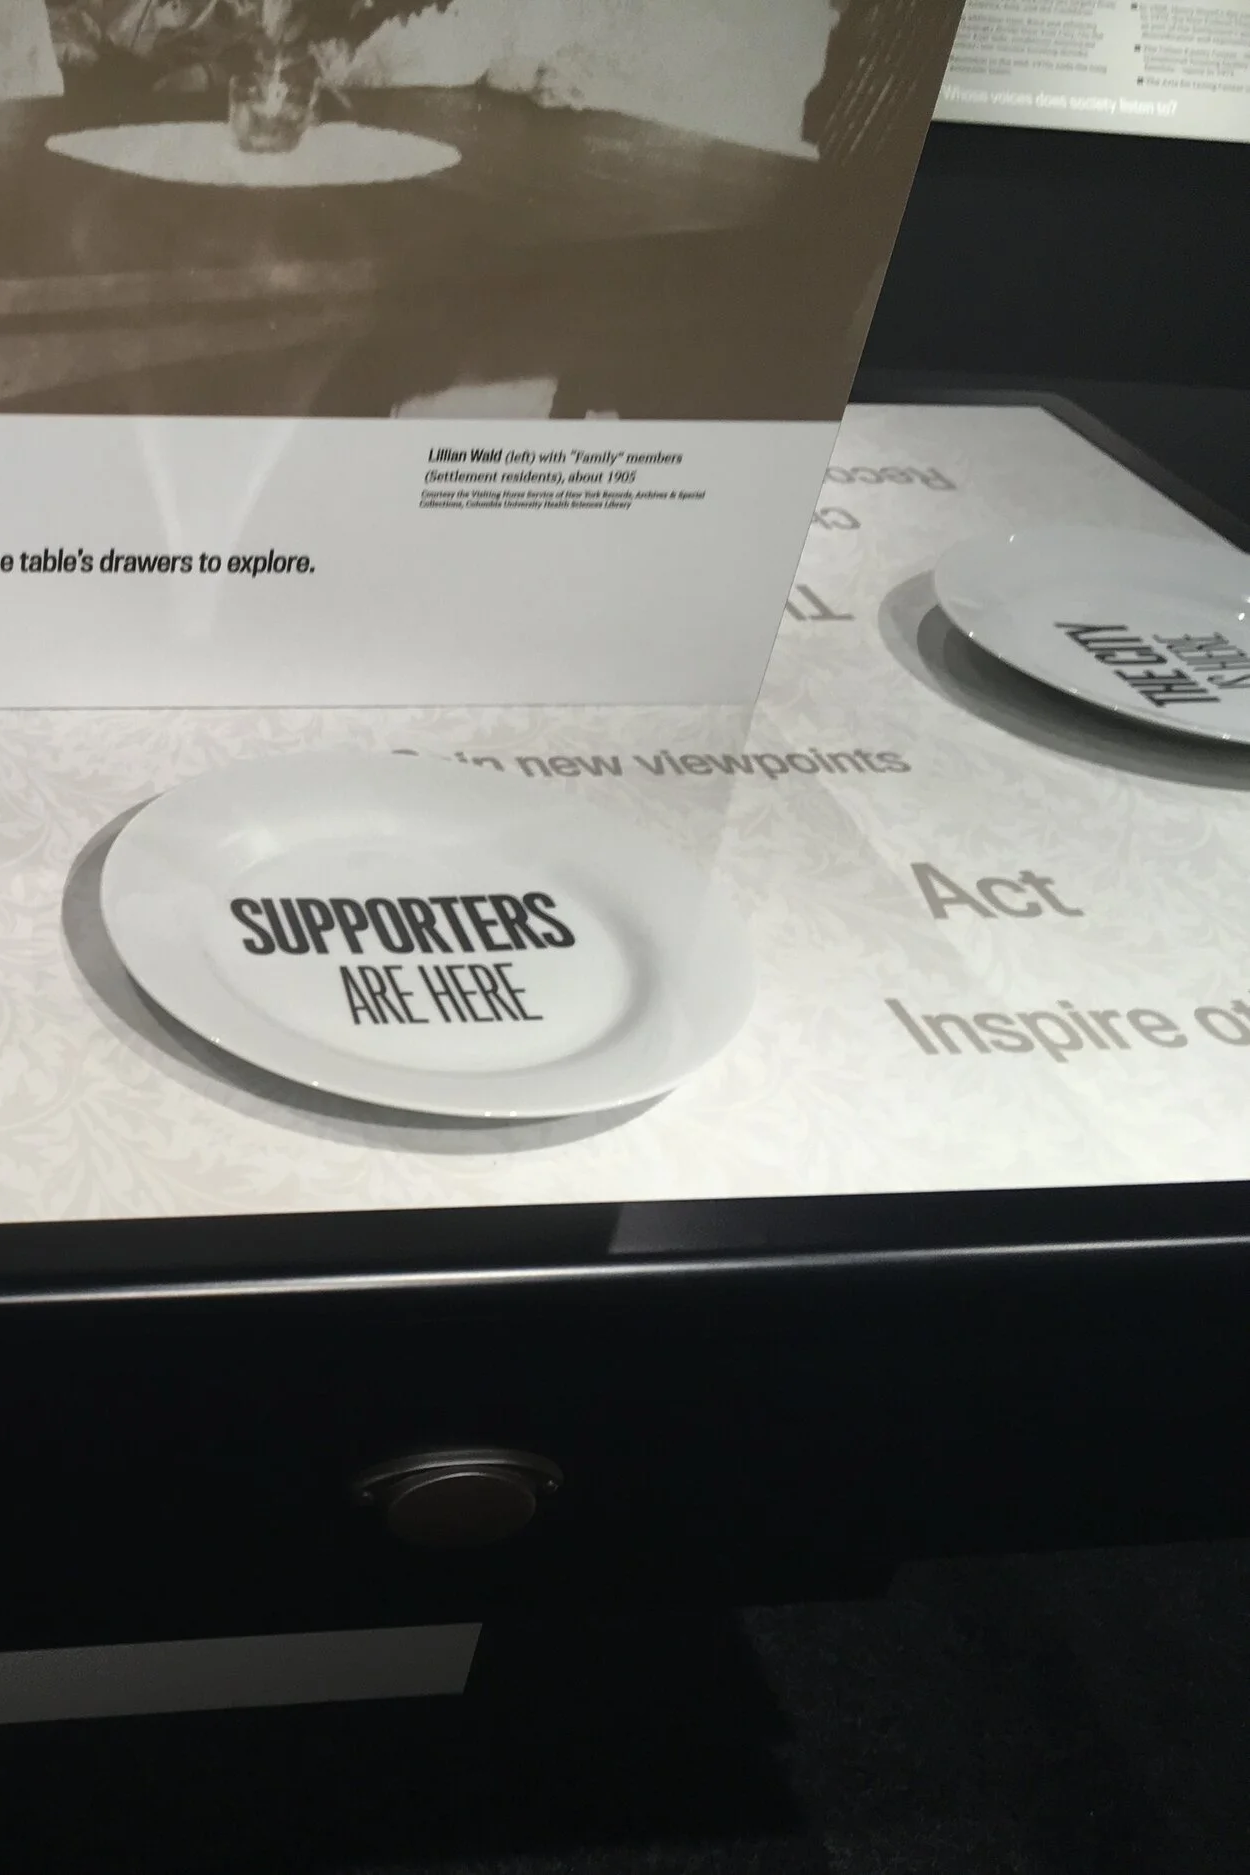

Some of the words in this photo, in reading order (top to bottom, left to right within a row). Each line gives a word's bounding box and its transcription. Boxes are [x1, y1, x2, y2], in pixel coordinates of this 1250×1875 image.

[1035, 90, 1066, 109] does
[428, 447, 467, 463] Lillian
[470, 447, 503, 463] Wald
[505, 449, 536, 466] (left)
[539, 449, 567, 464] with
[626, 449, 684, 465] members
[424, 469, 498, 485] (Settlement
[500, 470, 565, 485] residents),
[568, 470, 603, 484] about
[607, 470, 637, 484] 1905
[20, 548, 93, 575] table's
[99, 548, 192, 575] drawers
[199, 550, 222, 575] to
[227, 549, 316, 578] explore.
[1054, 622, 1168, 665] CITY
[1113, 668, 1221, 707] THE
[516, 752, 624, 777] new
[633, 747, 912, 780] viewpoints
[910, 862, 1085, 919] Act
[230, 891, 576, 955] SUPPORTERS
[339, 964, 429, 1026] ARE
[418, 962, 544, 1024] HERE
[884, 997, 1188, 1063] Inspire
